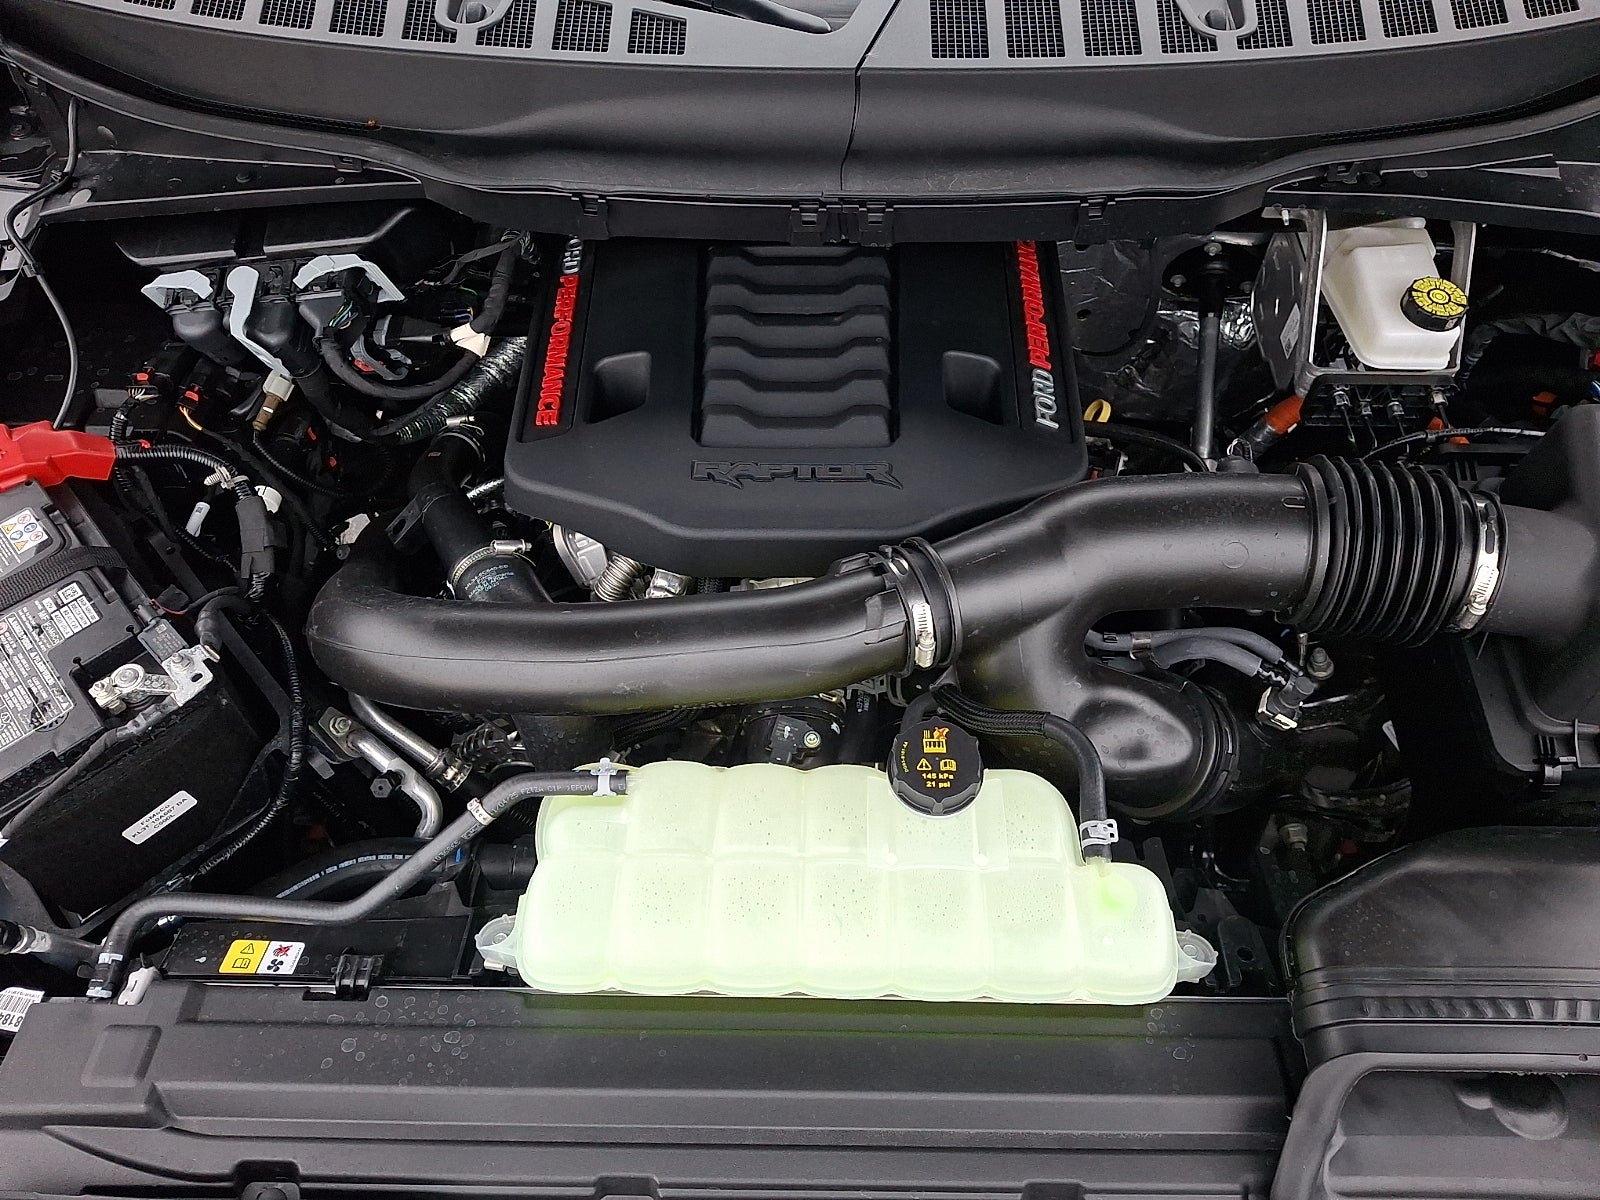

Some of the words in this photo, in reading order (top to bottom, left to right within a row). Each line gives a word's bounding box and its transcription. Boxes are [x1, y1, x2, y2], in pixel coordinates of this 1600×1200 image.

[562, 234, 583, 274] ORD
[534, 274, 580, 426] PERFORMANCE
[1031, 368, 1060, 429] FORD
[691, 460, 904, 490] RAPTOR
[921, 772, 937, 780] 145
[938, 772, 955, 780] kPa
[938, 780, 951, 789] psi
